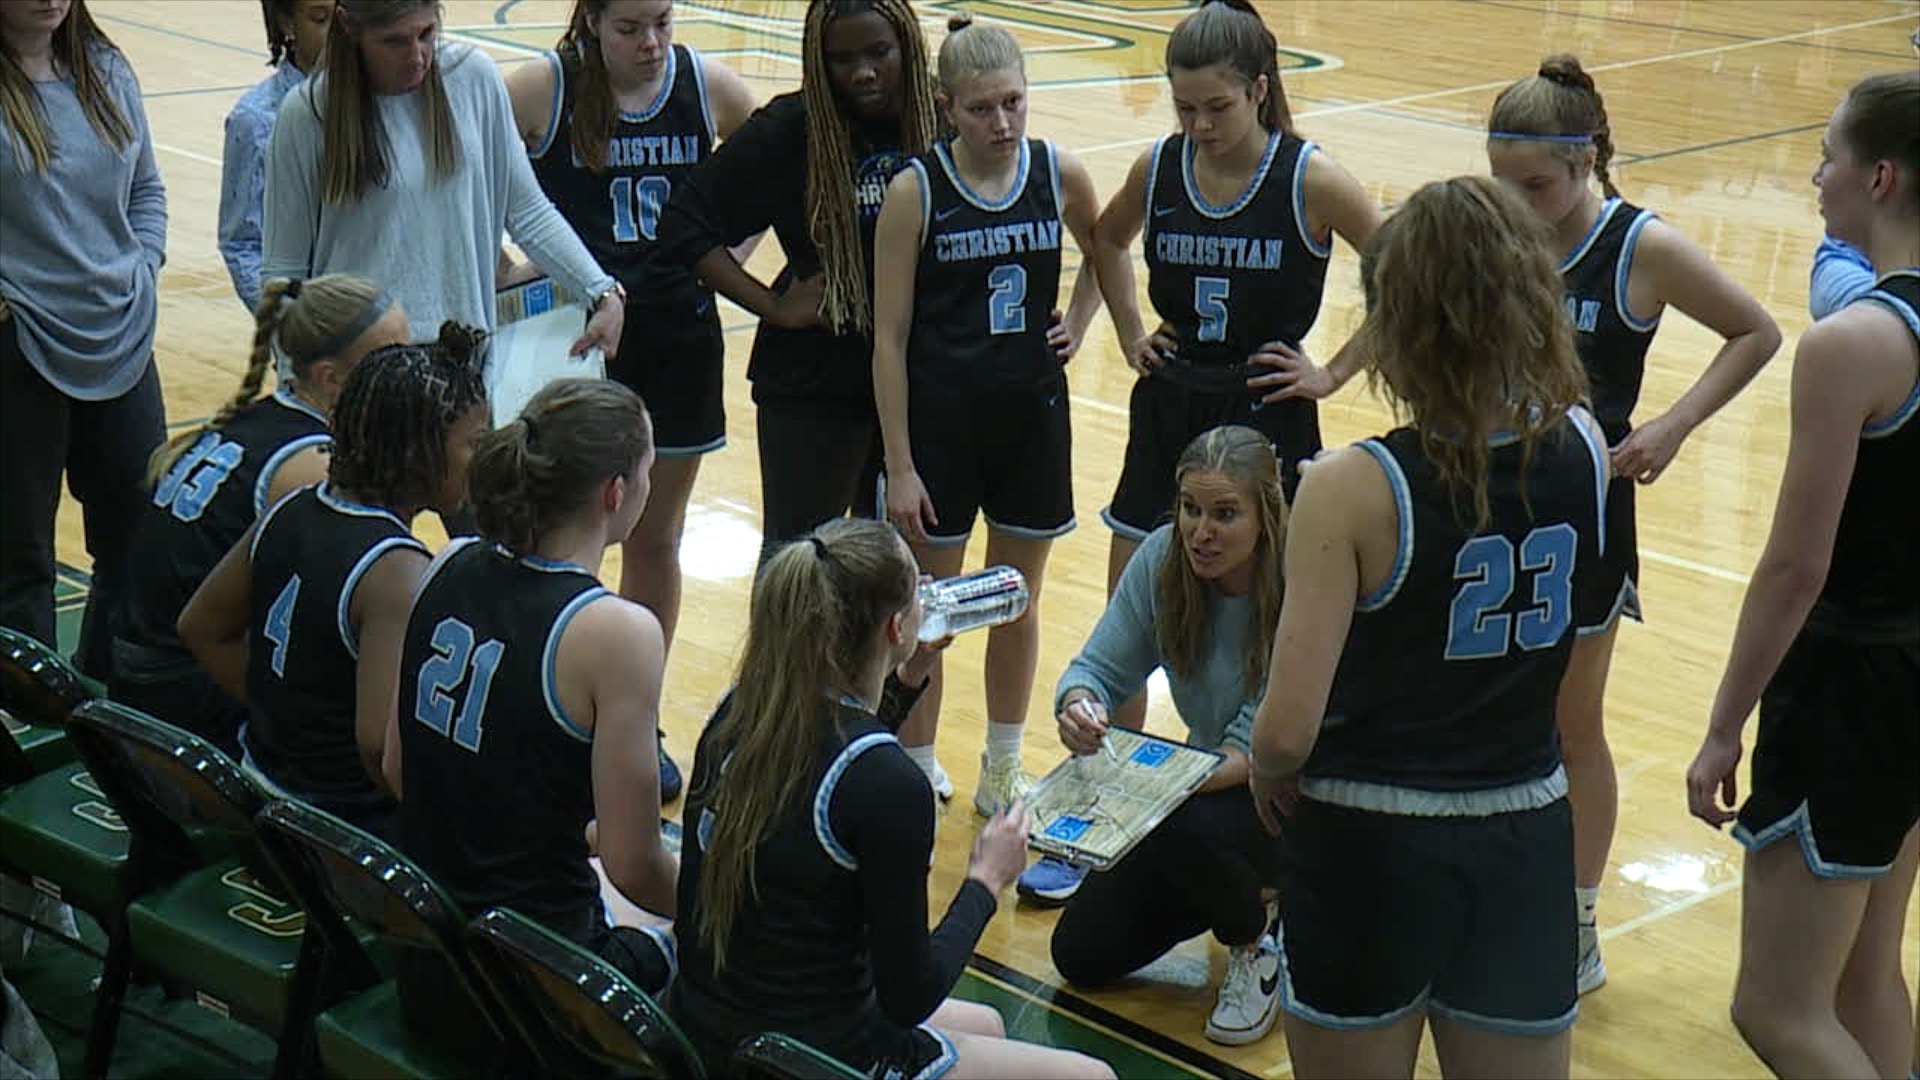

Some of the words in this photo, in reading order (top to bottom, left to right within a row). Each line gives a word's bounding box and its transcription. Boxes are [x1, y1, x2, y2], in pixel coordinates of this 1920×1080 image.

[609, 175, 671, 242] 10
[1156, 231, 1283, 270] CHRISTIAN
[988, 263, 1027, 335] 2
[1194, 275, 1230, 342] 5
[264, 573, 300, 678] 4
[1444, 522, 1577, 660] 23
[415, 616, 505, 754] 21
